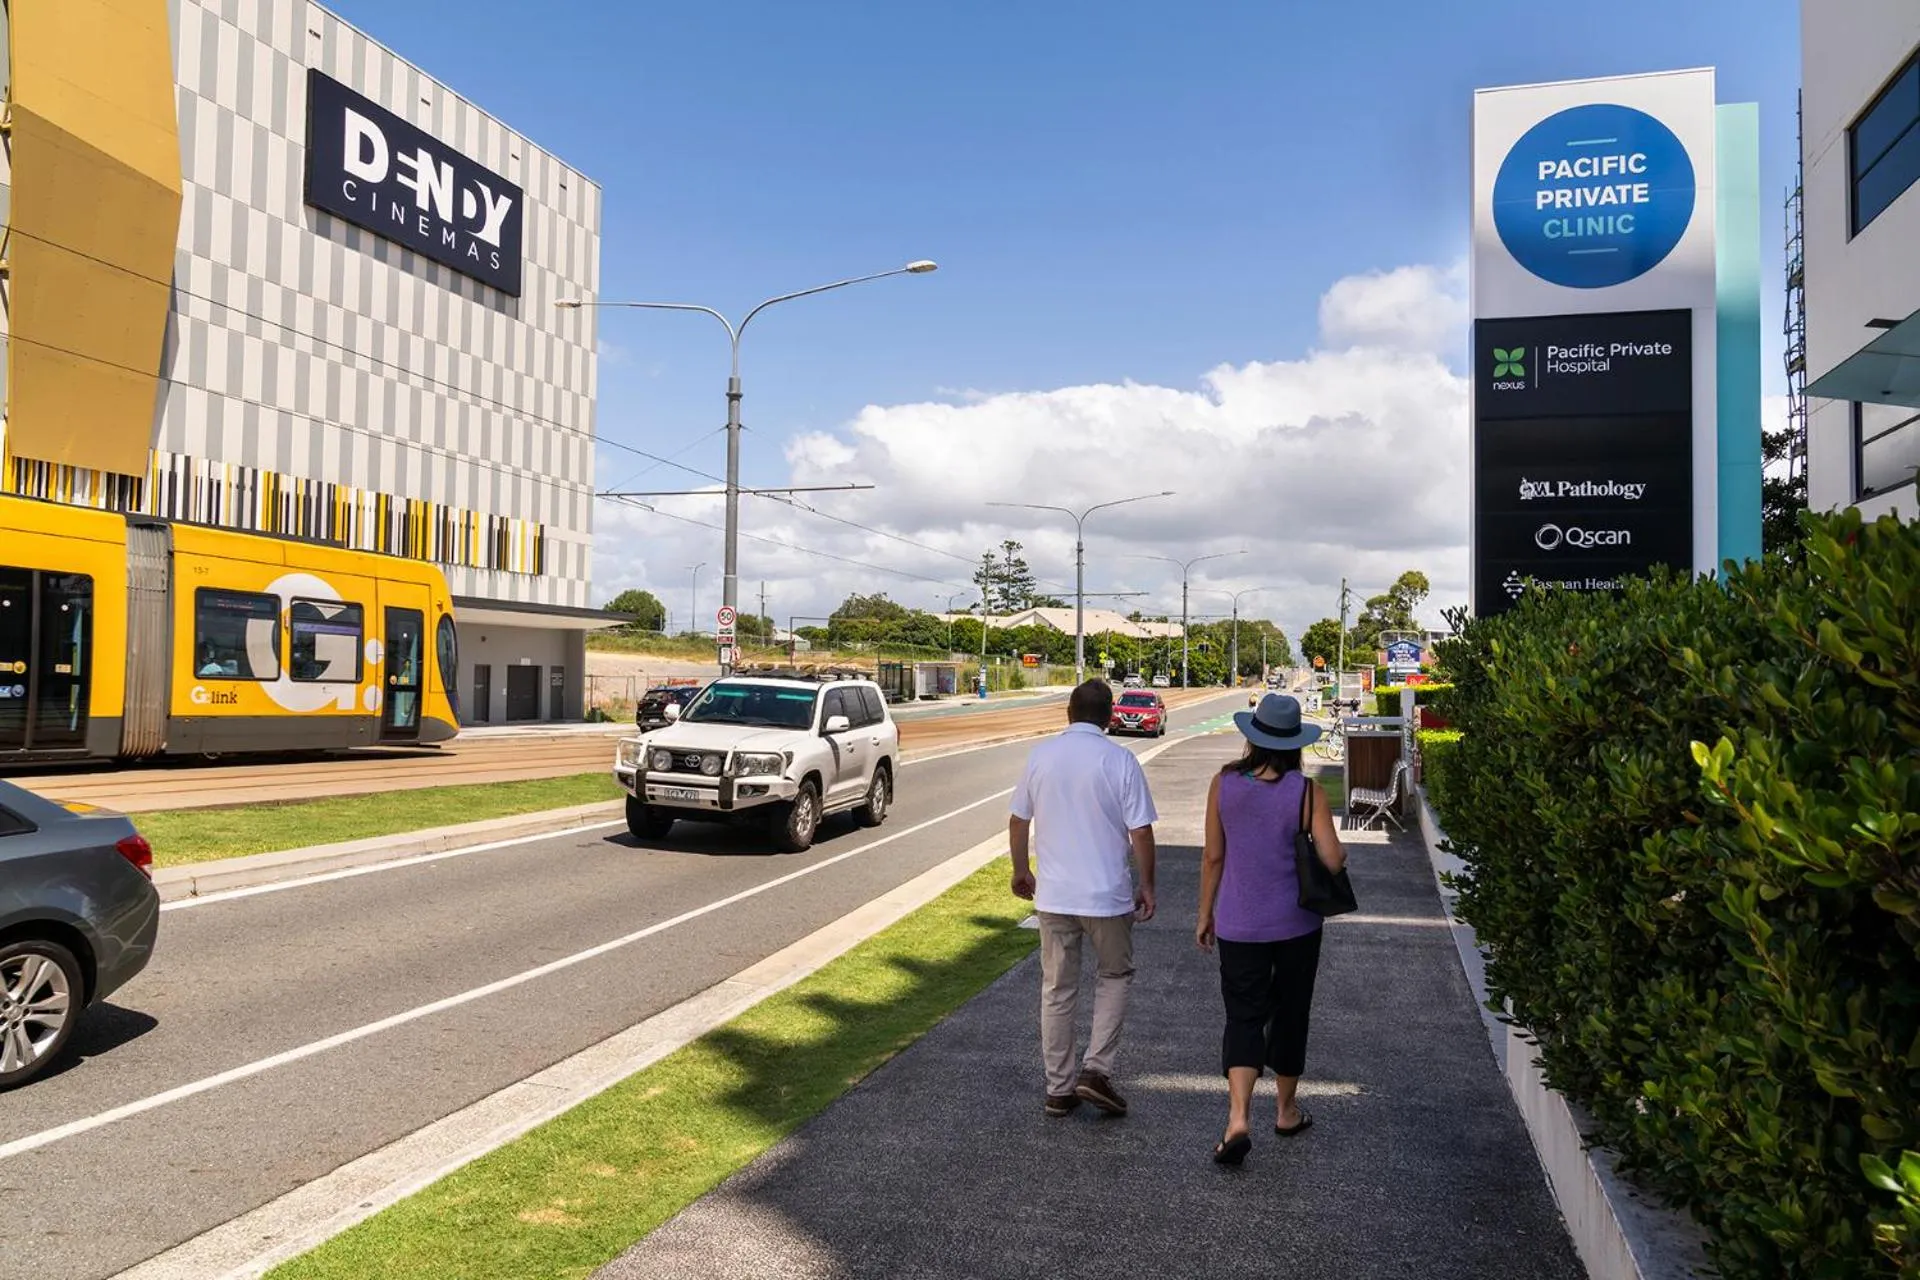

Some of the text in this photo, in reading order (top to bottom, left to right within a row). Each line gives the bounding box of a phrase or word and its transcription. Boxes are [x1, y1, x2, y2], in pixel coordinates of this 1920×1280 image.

[344, 107, 512, 248] DENDY
[1538, 153, 1647, 180] PACIFIC
[1536, 183, 1650, 210] PRIVATE
[343, 180, 500, 270] CINEMAS
[1543, 214, 1635, 239] CLINIC
[1547, 342, 1672, 359] Pacific Private
[1547, 358, 1610, 374] Hospital
[1493, 381, 1525, 390] nexus
[1557, 480, 1646, 499] Pathology
[1566, 527, 1631, 548] Qscan
